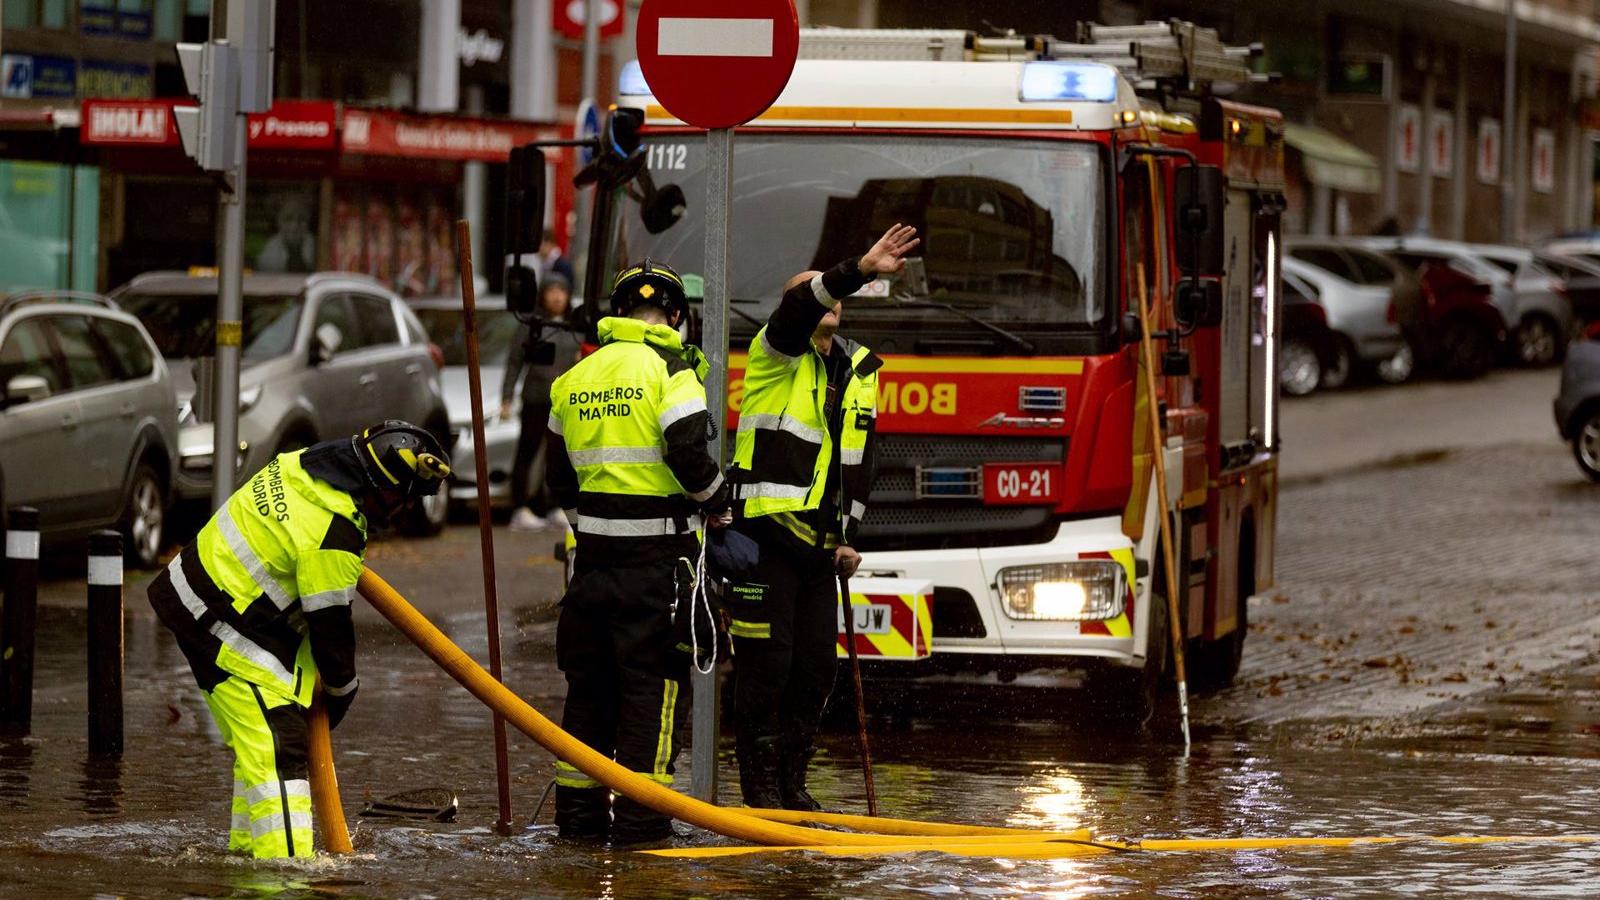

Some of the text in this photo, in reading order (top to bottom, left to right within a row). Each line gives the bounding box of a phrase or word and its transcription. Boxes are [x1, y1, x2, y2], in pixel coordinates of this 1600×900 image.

[92, 106, 165, 137] ¡HOLA!
[569, 386, 643, 406] BOMBEROS
[268, 458, 290, 523] BOMBEROS
